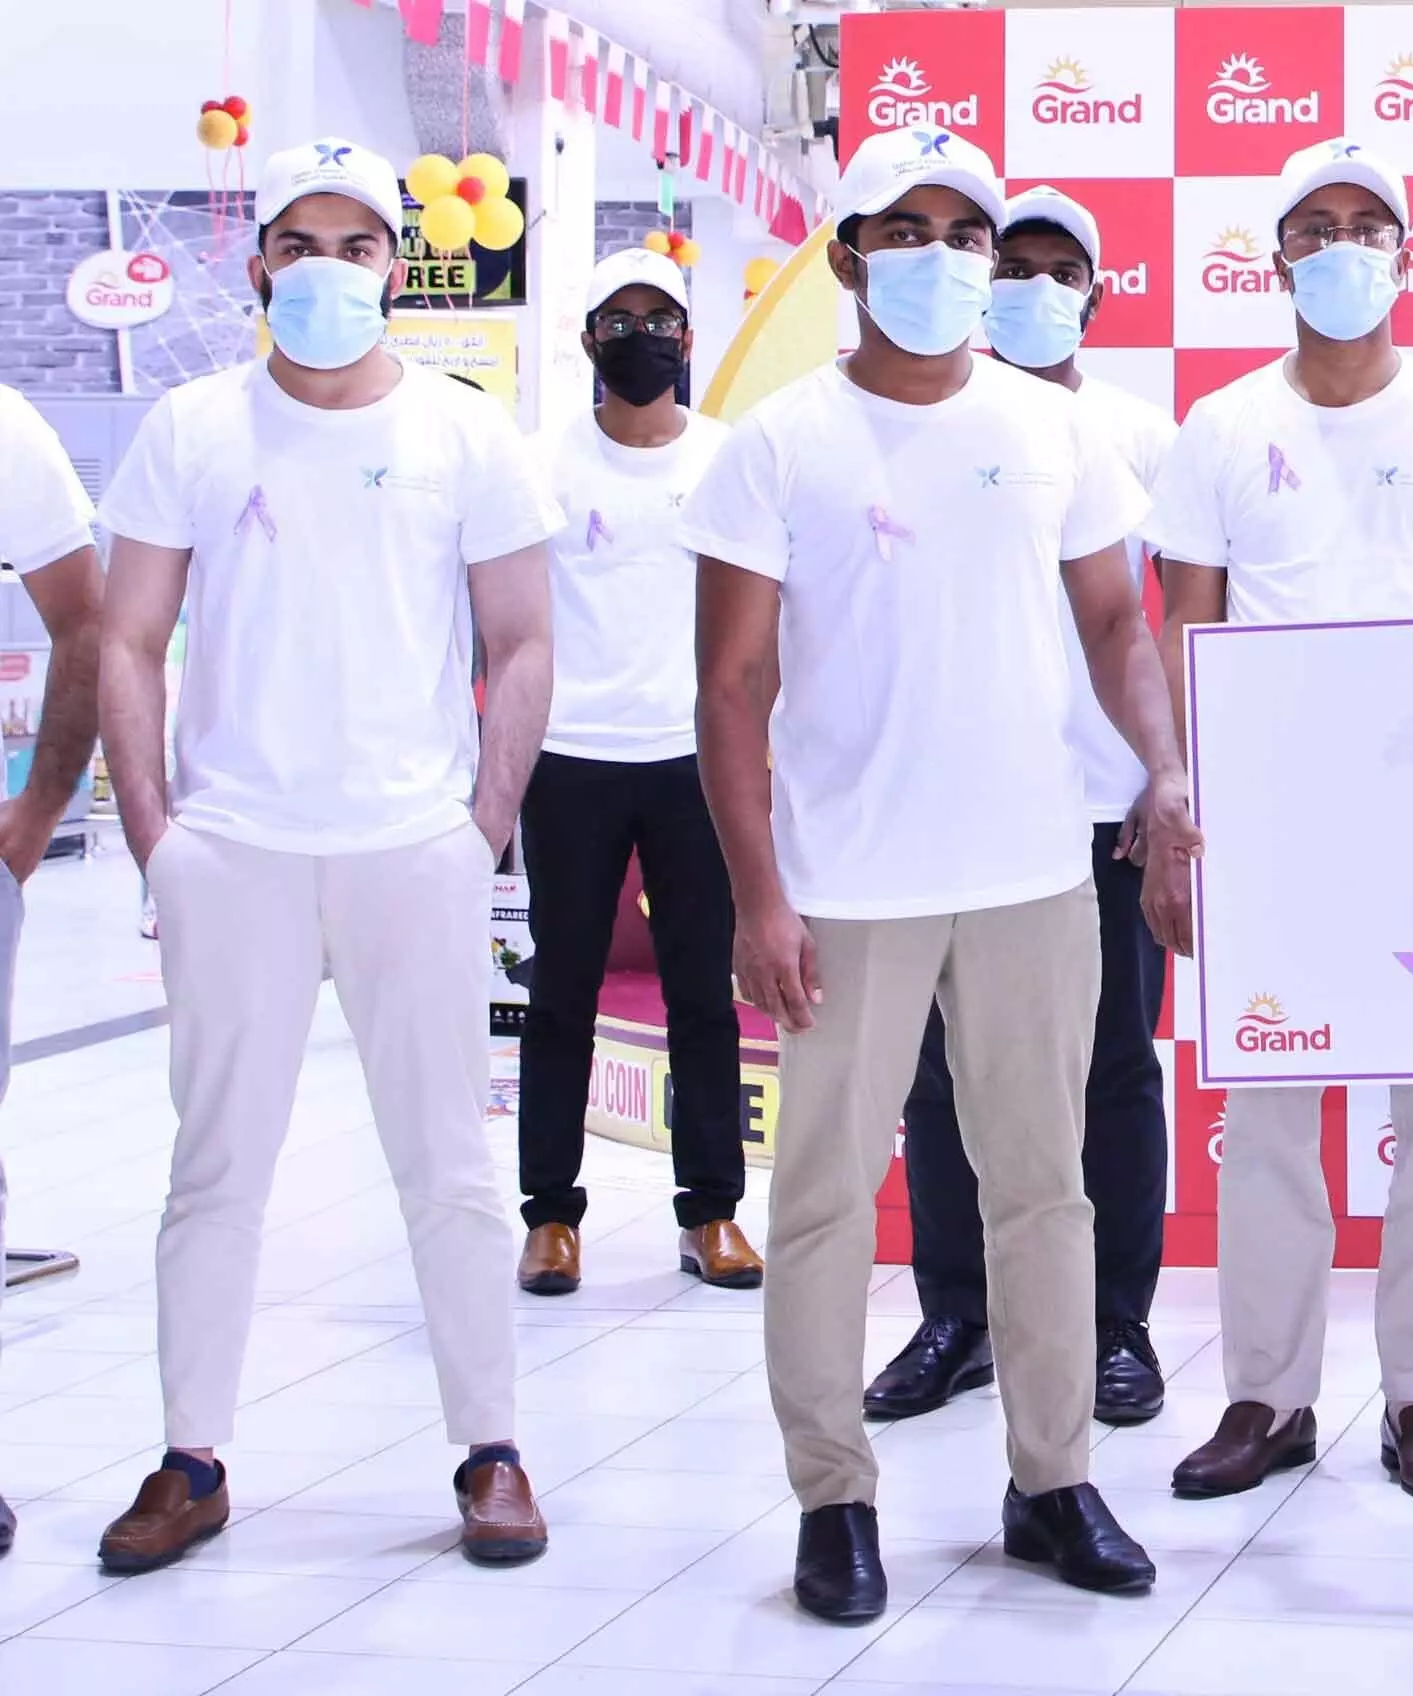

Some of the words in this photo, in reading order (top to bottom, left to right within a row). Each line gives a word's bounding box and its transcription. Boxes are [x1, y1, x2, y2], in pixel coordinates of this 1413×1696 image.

[868, 94, 977, 127] Grand
[1032, 93, 1141, 124] Grand
[1206, 91, 1319, 124] Grand
[405, 266, 465, 288] REE
[1202, 263, 1282, 293] Gran
[86, 288, 152, 308] Grand
[1236, 1023, 1331, 1053] Grand
[604, 1059, 647, 1122] COIN
